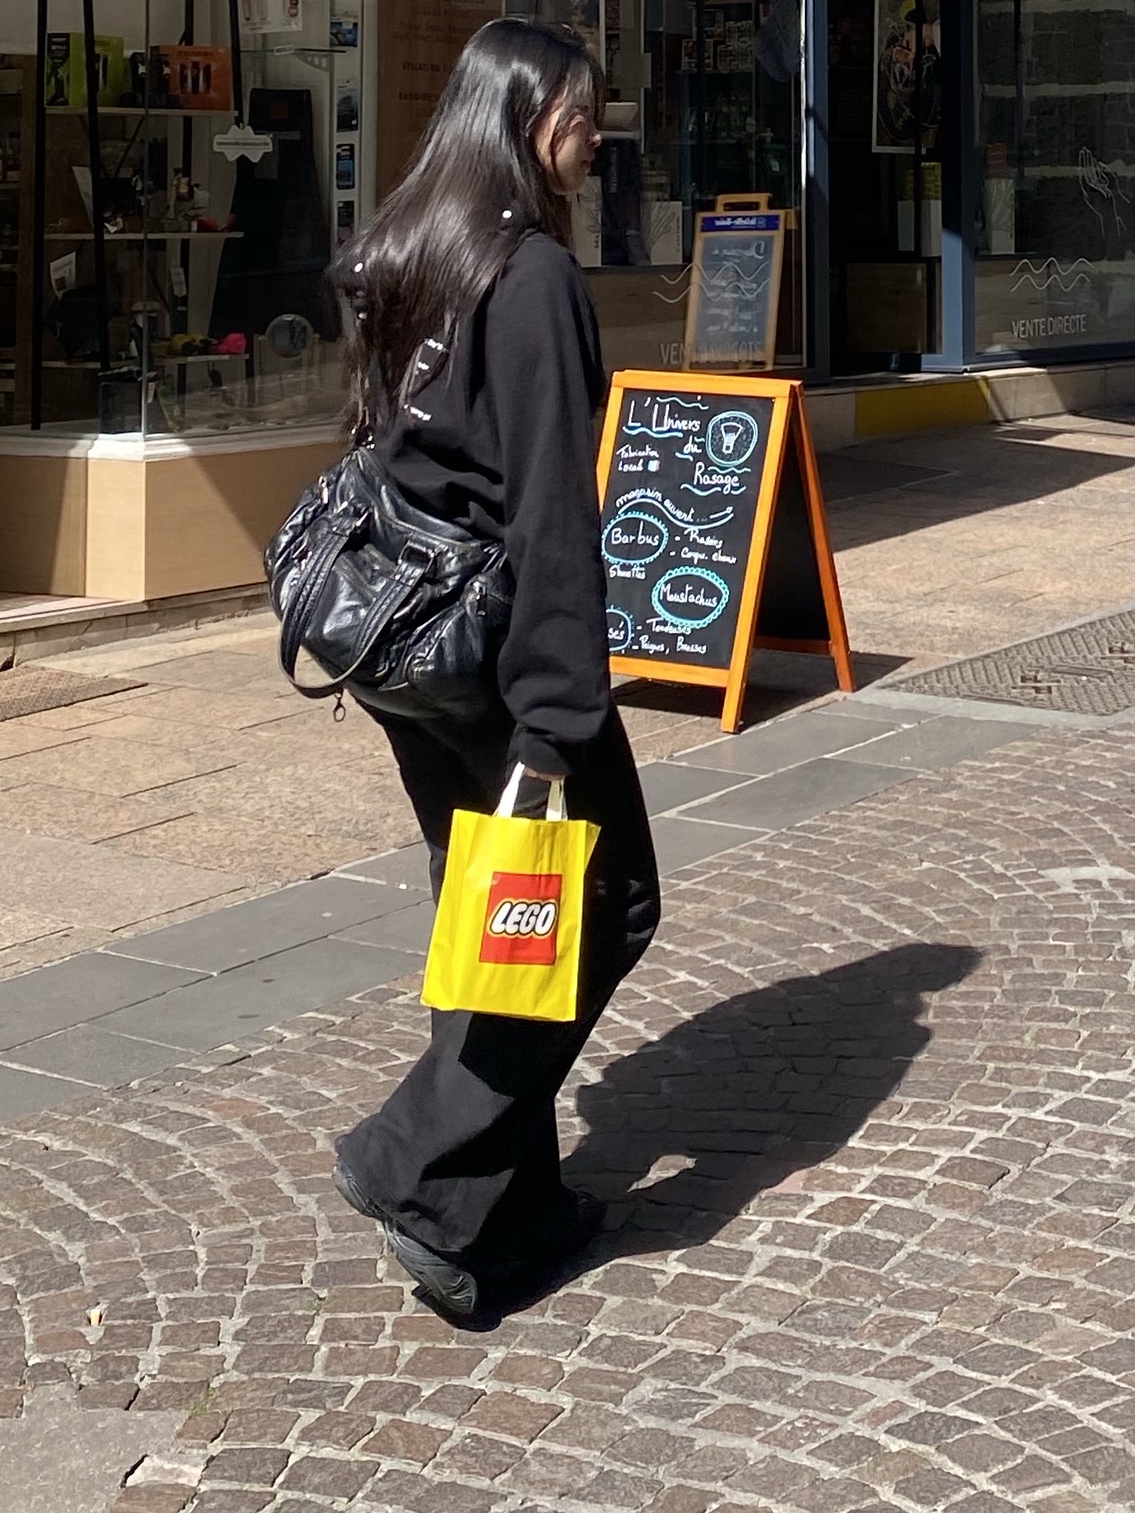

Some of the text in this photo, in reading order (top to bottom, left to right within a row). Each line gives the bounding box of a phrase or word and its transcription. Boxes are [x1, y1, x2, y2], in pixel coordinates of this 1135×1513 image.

[1011, 314, 1087, 339] VENTE DIRECTE
[683, 435, 702, 454] du
[693, 462, 740, 494] Rasage
[611, 520, 660, 546] Barbus
[660, 583, 718, 607] Moustachus
[490, 900, 557, 937] LEGO
